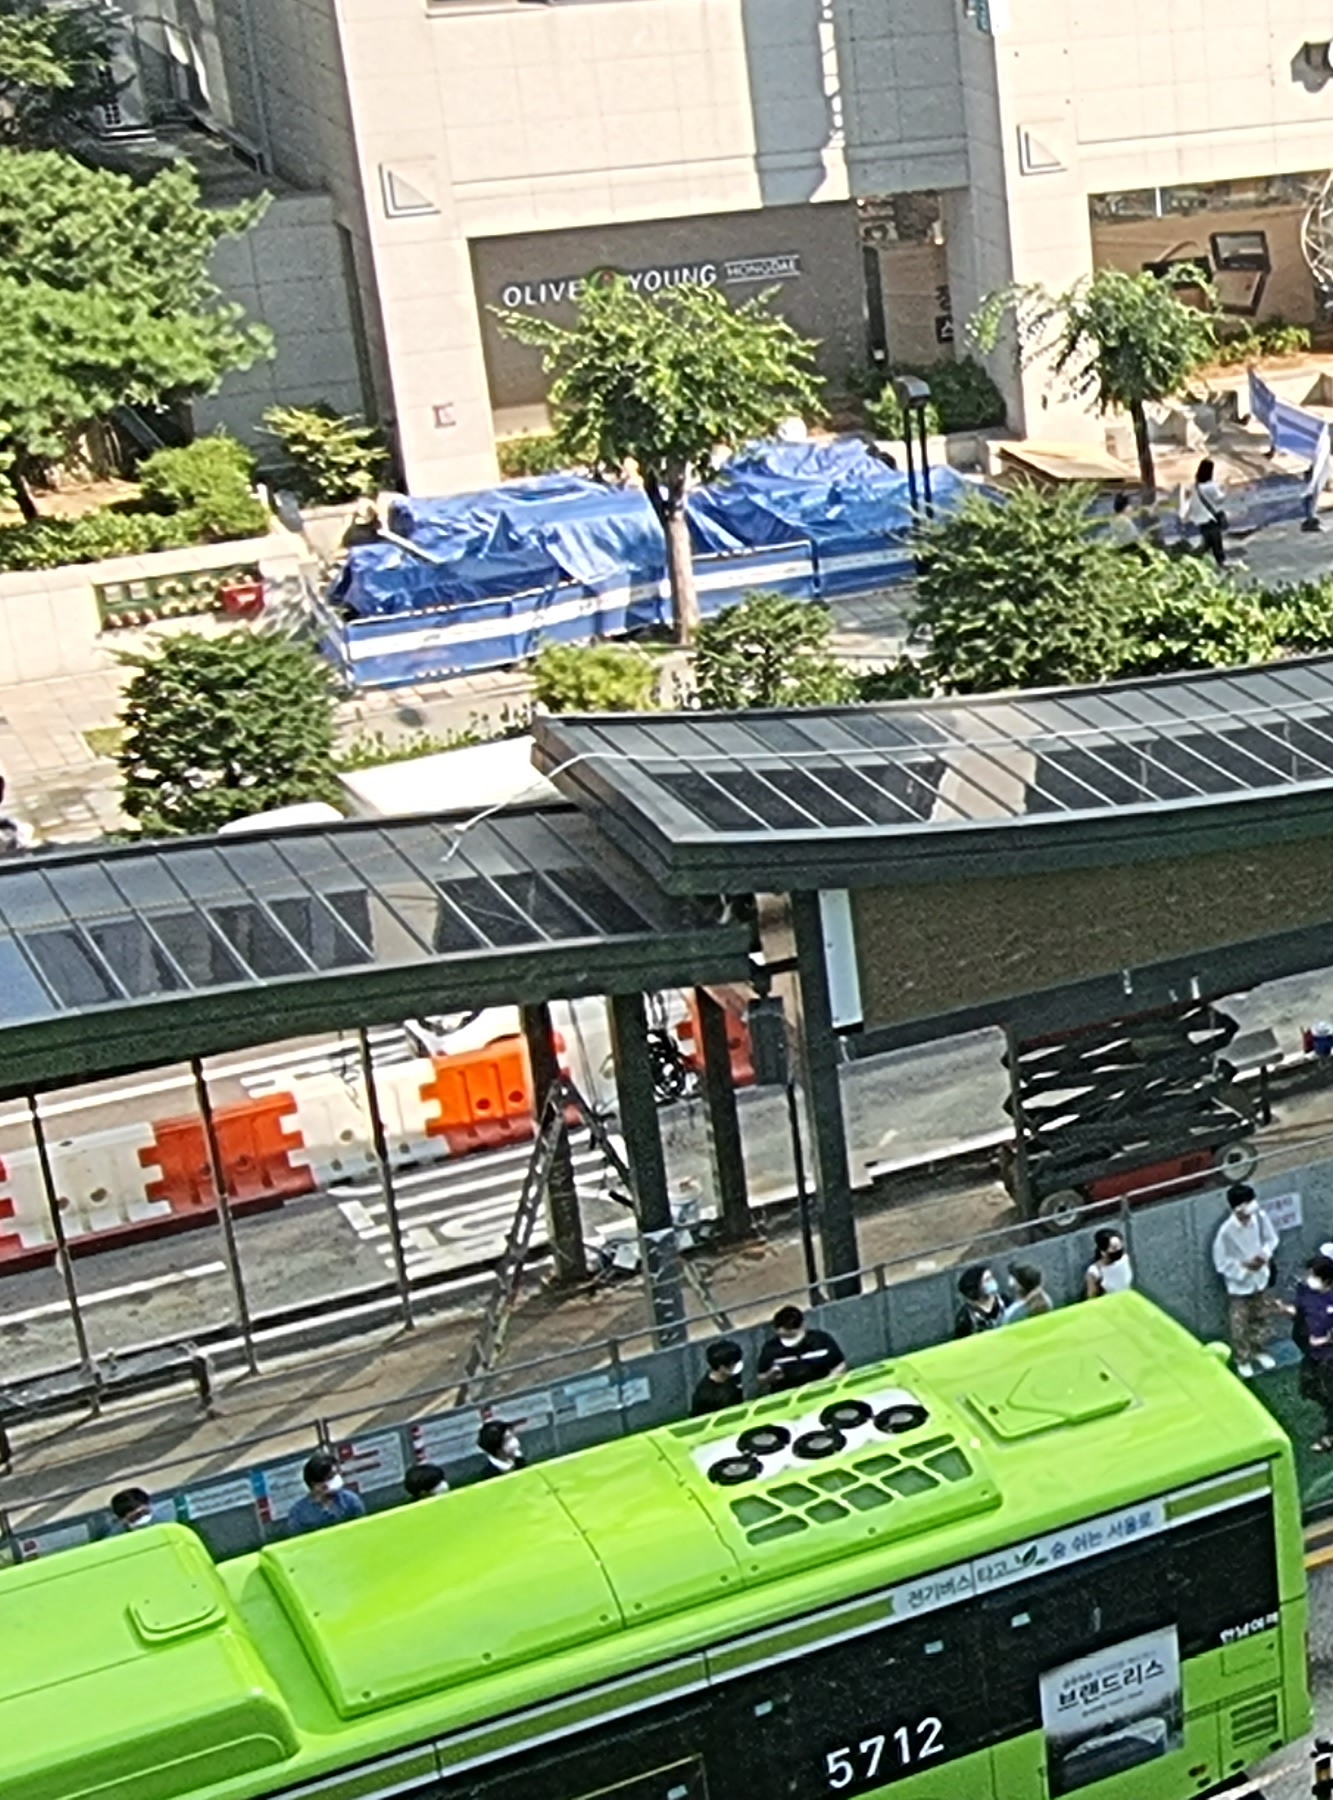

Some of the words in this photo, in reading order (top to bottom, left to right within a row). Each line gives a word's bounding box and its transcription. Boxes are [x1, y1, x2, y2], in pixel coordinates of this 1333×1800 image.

[502, 280, 584, 307] OLIVE
[627, 264, 717, 291] YOUNG
[907, 1573, 972, 1610] 전기버스
[976, 1560, 1008, 1583] 타고
[1071, 1529, 1104, 1553] 쉬는
[1106, 1510, 1155, 1540] 서울로
[1056, 1659, 1165, 1712] 브랜드리스
[826, 1716, 945, 1789] 5712
